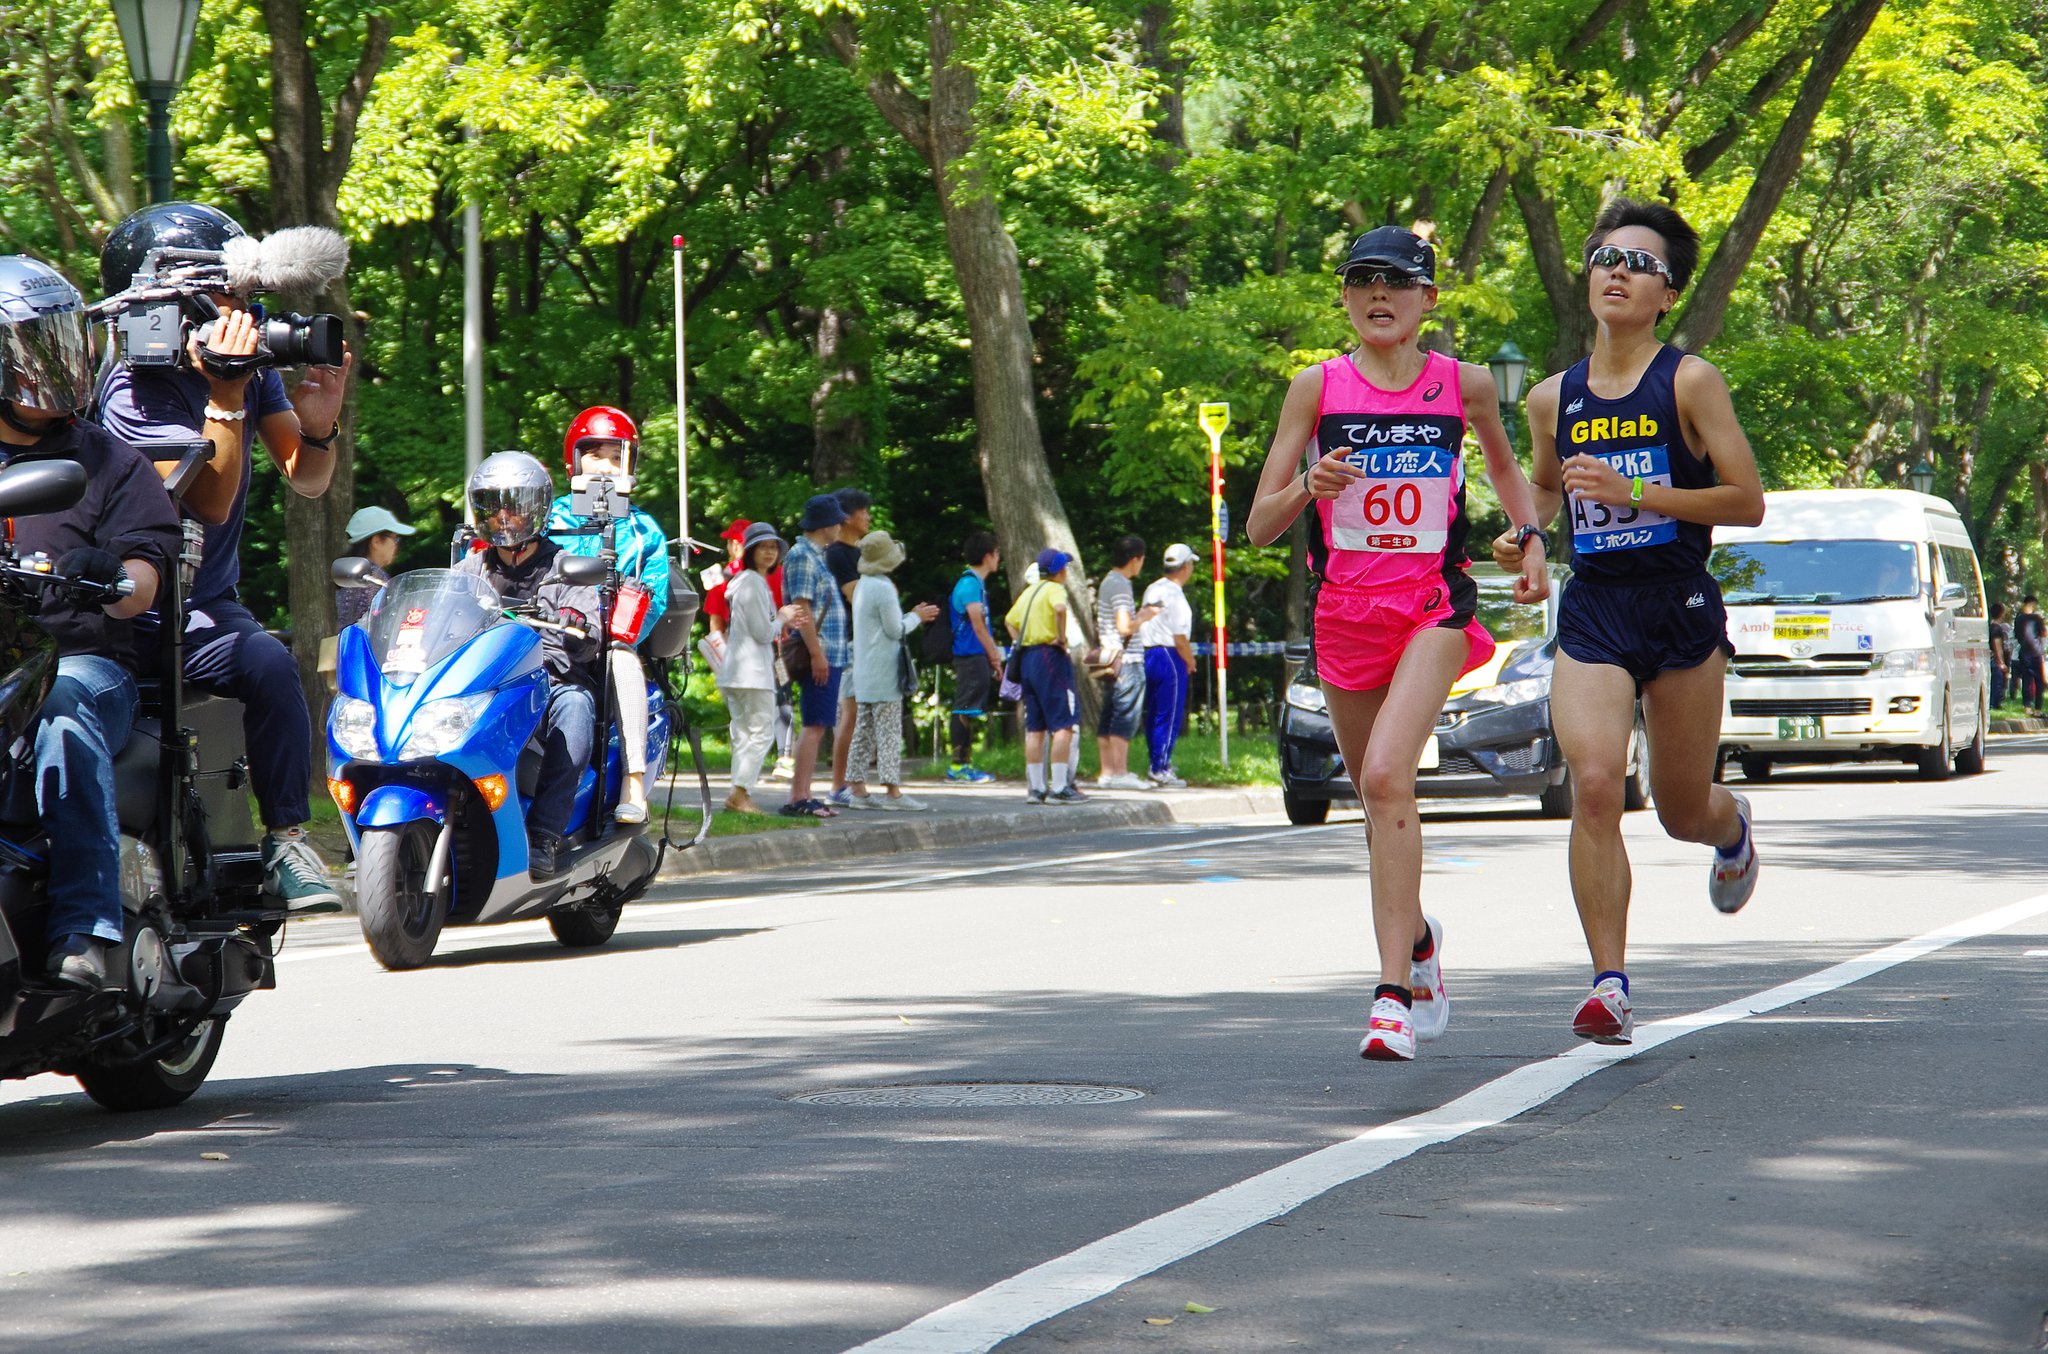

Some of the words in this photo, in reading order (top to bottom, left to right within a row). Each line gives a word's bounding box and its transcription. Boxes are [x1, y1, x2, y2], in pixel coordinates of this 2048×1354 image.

[149, 314, 161, 331] 2
[1341, 423, 1442, 443] てんまや
[1571, 414, 1658, 444] GRlab
[1345, 450, 1443, 473] 白い恋人
[1363, 483, 1422, 526] 60
[1371, 536, 1412, 547] 第一生命
[1605, 529, 1653, 548] ホクレン
